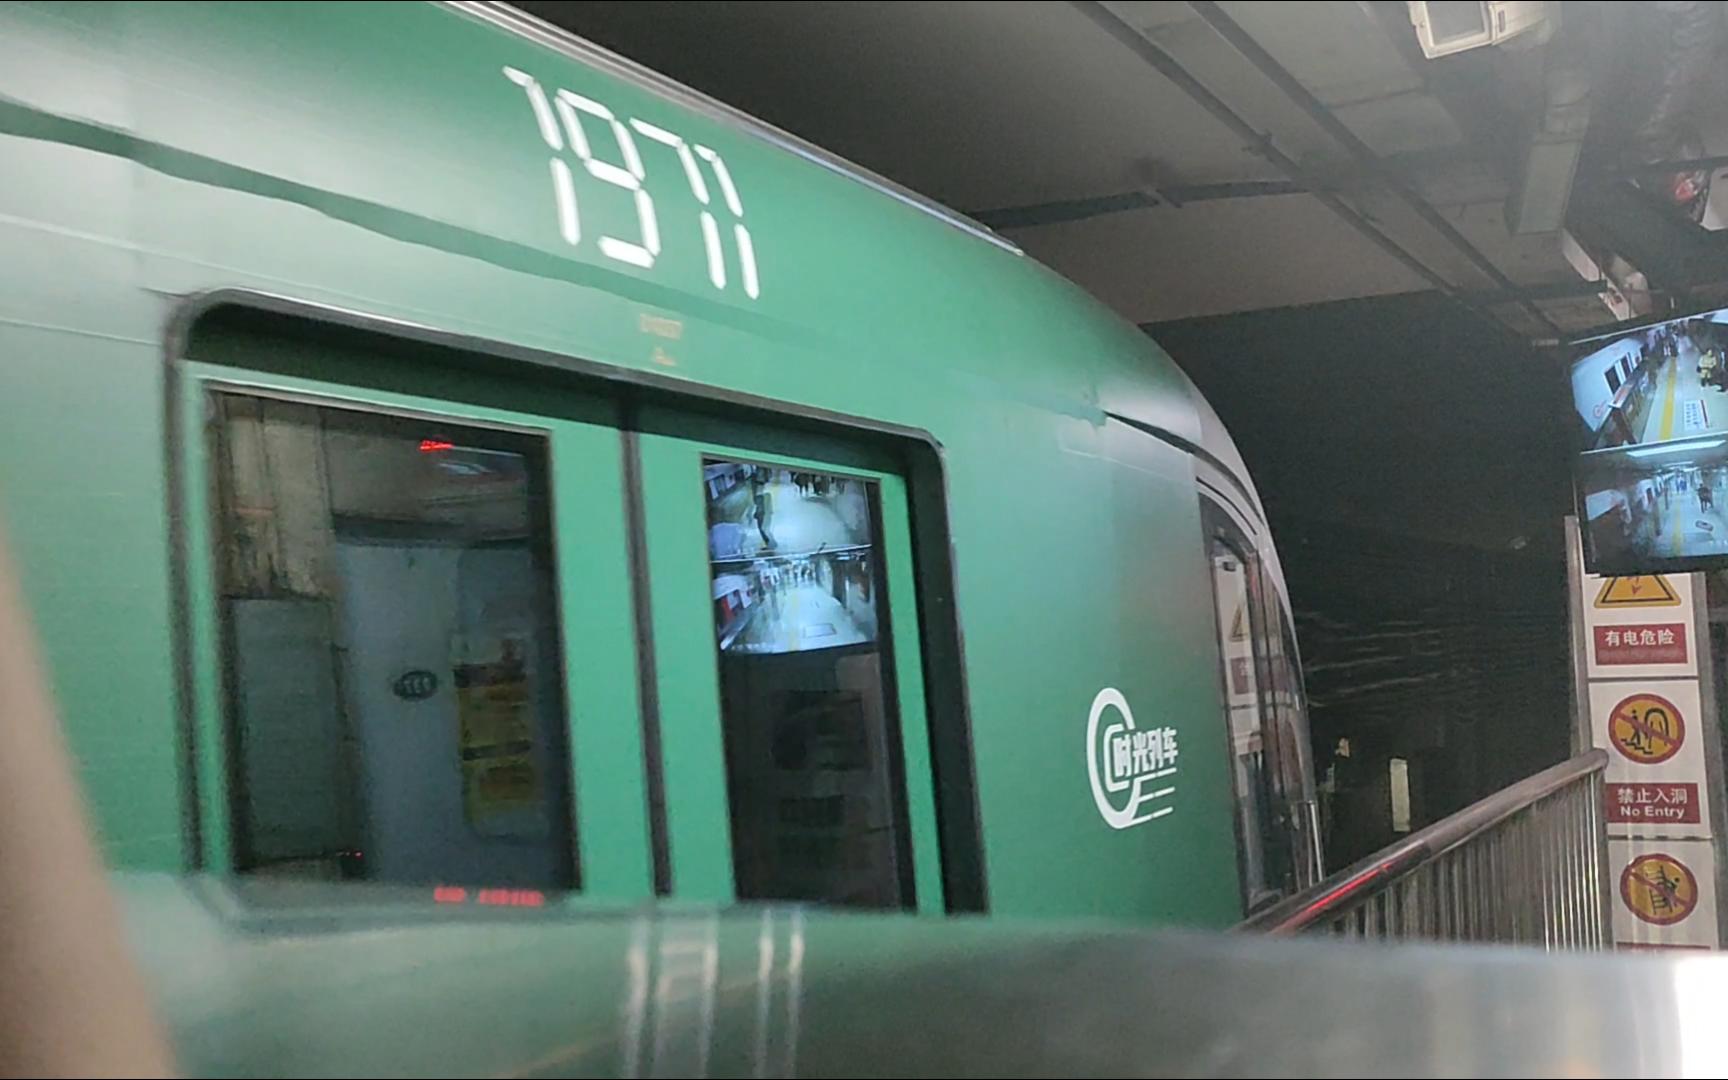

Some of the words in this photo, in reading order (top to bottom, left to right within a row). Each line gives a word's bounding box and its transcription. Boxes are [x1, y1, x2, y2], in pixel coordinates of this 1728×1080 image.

[503, 65, 760, 300] 1971
[1605, 628, 1675, 647] 有电危险
[1112, 726, 1179, 778] 时光列车
[1617, 788, 1688, 805] 禁止入洞
[1620, 806, 1640, 818] No
[1644, 806, 1685, 820] Entry
